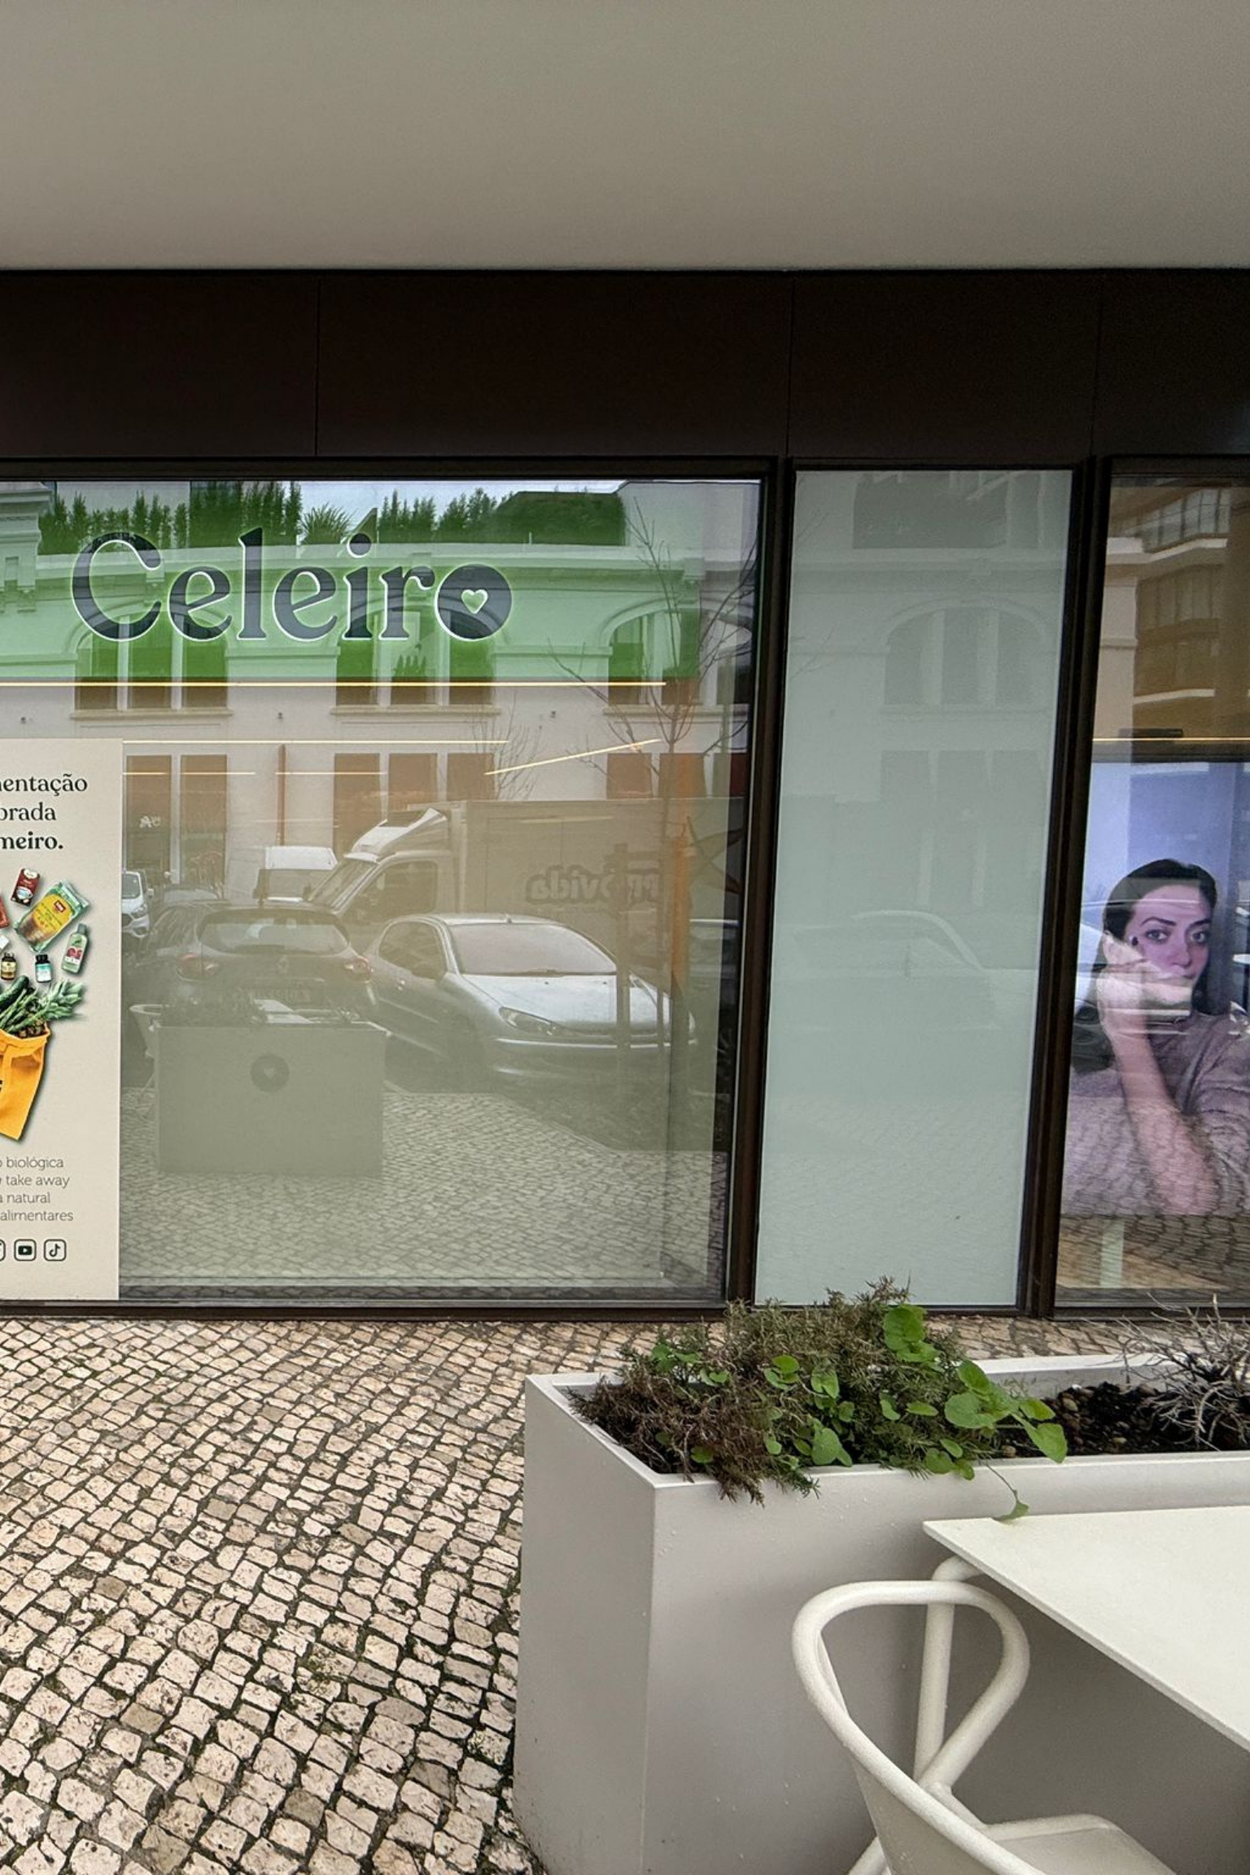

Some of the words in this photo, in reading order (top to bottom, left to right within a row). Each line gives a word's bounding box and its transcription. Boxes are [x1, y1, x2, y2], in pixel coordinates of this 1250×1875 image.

[70, 526, 513, 642] Celeiro
[6, 1156, 64, 1171] biológica
[6, 1174, 32, 1186] take
[35, 1177, 70, 1189] away
[6, 1191, 51, 1204] natural
[0, 1210, 74, 1222] alimentares
